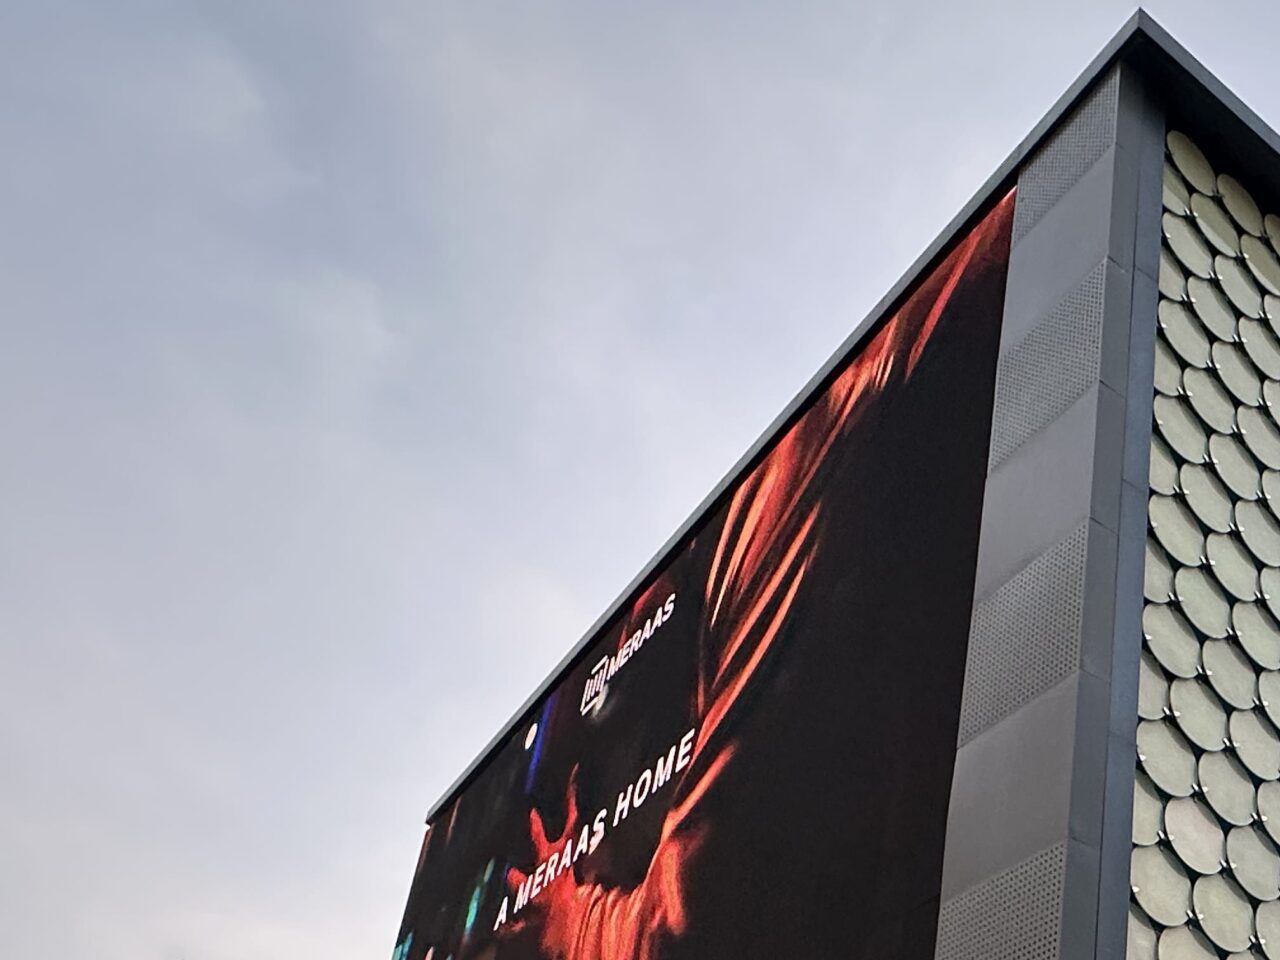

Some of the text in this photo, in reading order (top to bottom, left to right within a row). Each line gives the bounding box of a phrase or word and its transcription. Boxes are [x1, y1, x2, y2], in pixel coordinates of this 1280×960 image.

[606, 592, 676, 681] MERAAS
[493, 728, 696, 931] A MERAAS HOME
